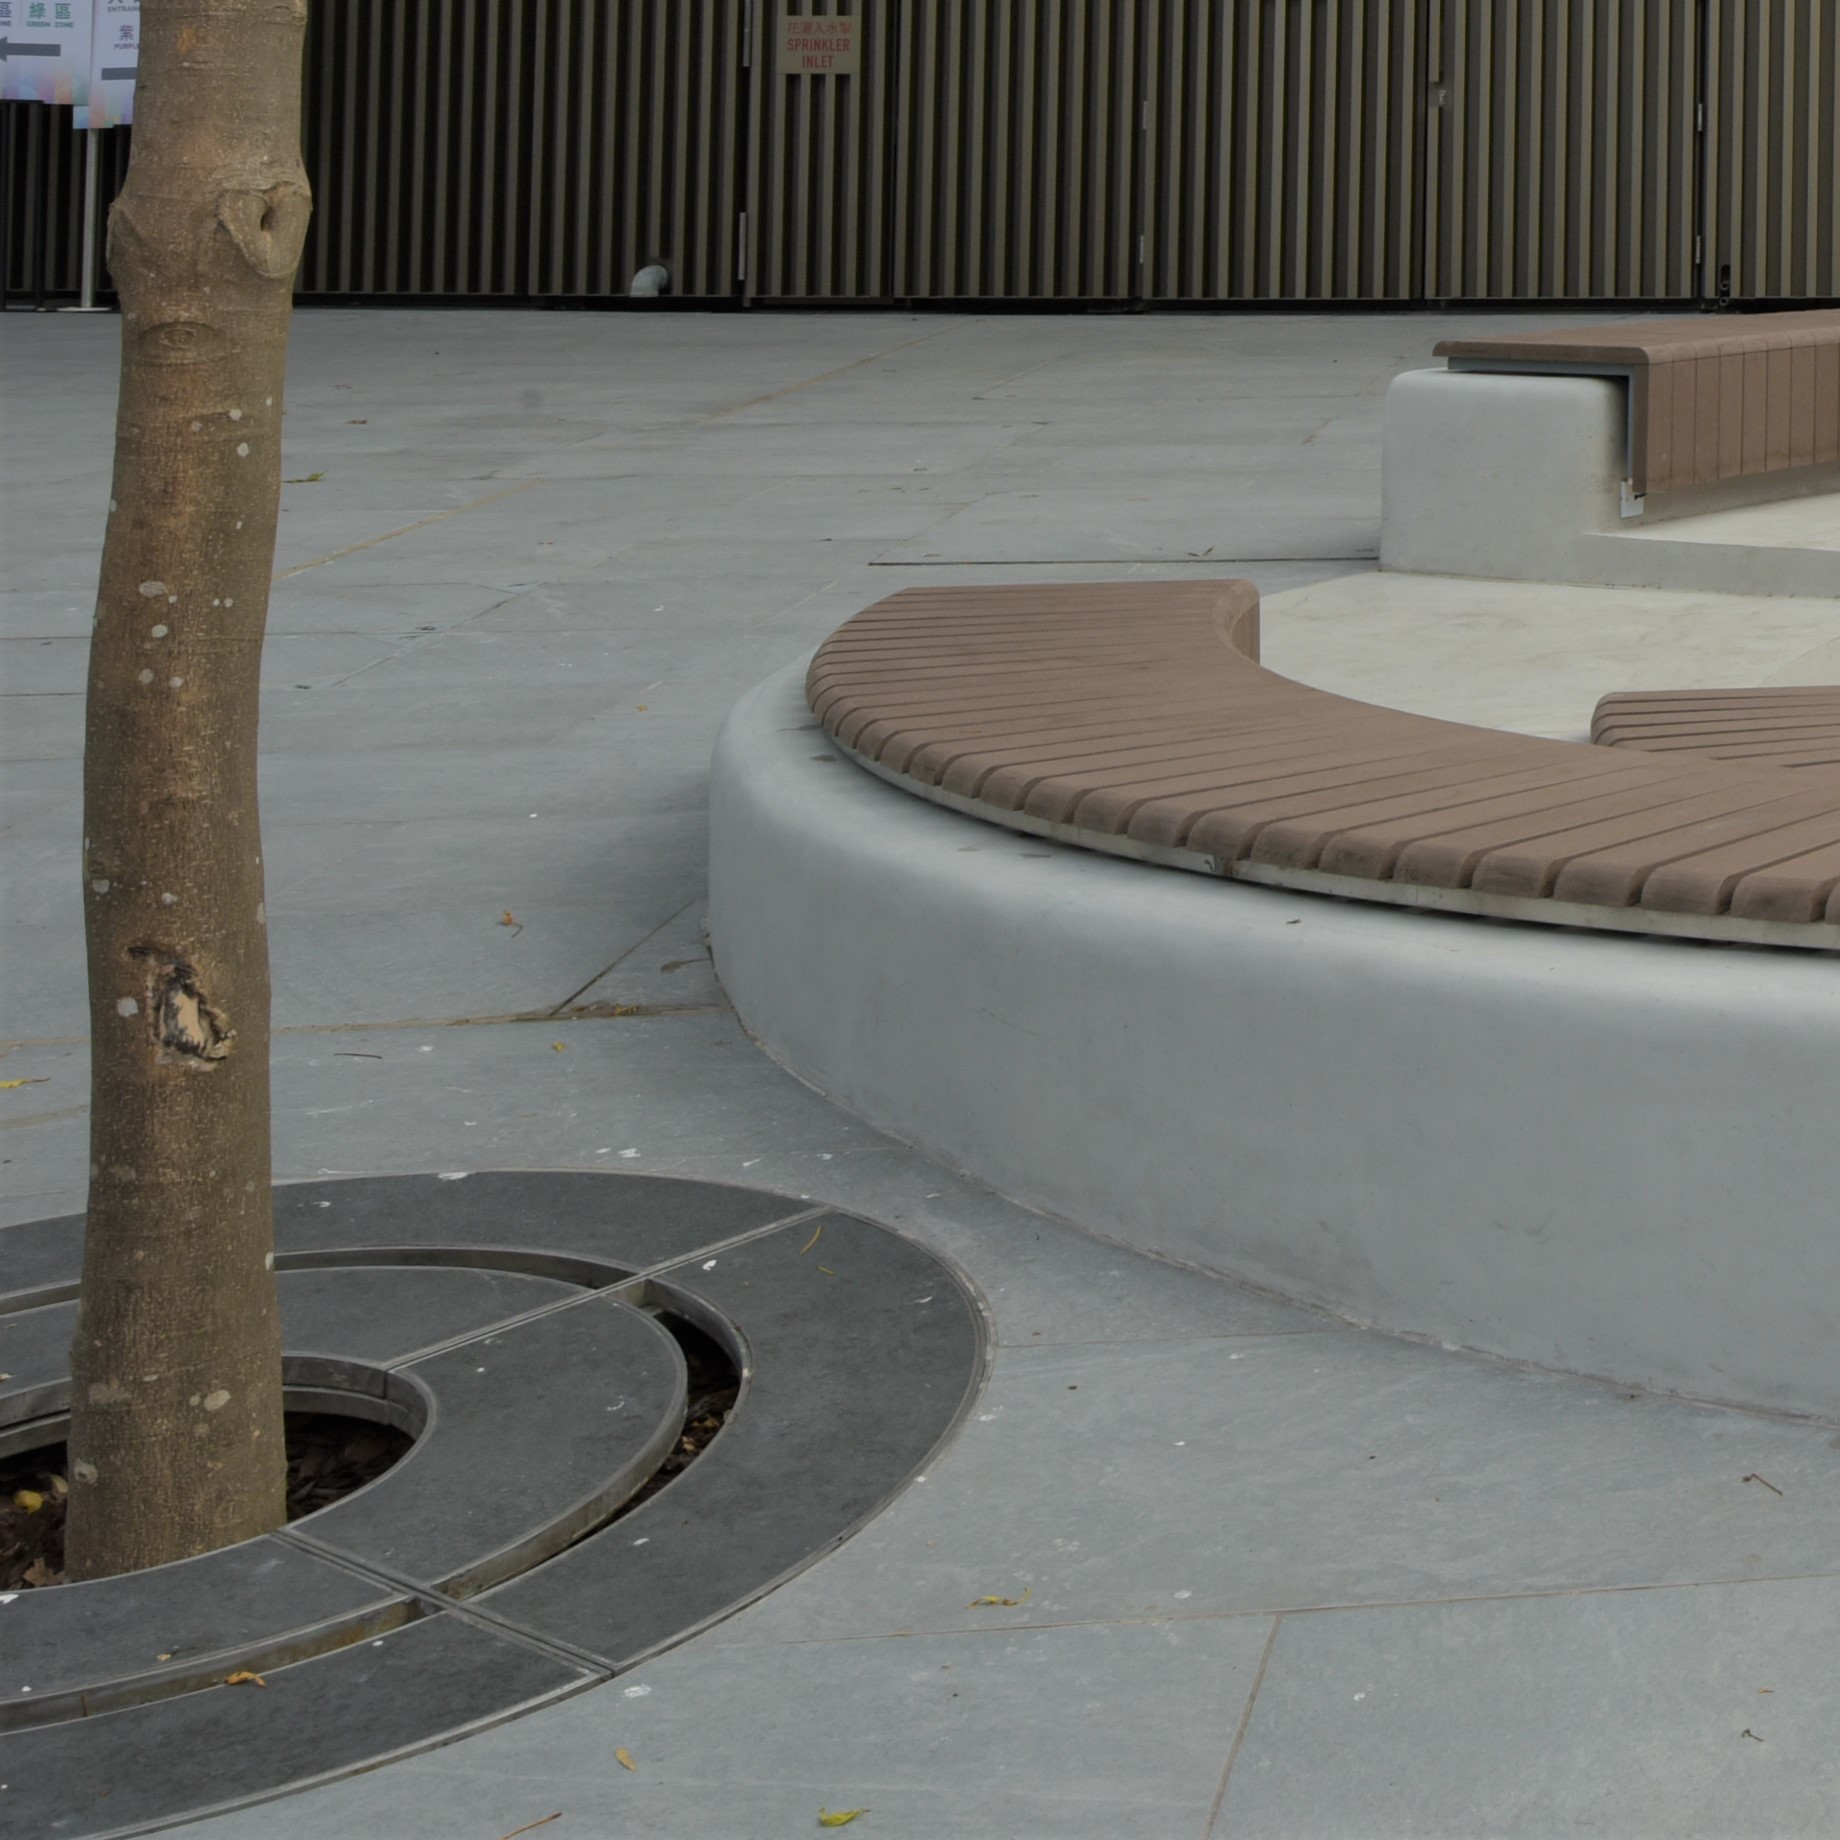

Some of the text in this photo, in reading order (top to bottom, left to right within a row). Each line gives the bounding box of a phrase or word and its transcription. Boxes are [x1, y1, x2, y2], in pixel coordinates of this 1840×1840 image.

[107, 5, 141, 13] ENTRAN
[786, 38, 851, 52] SPRINKLER
[801, 54, 834, 69] INLET
